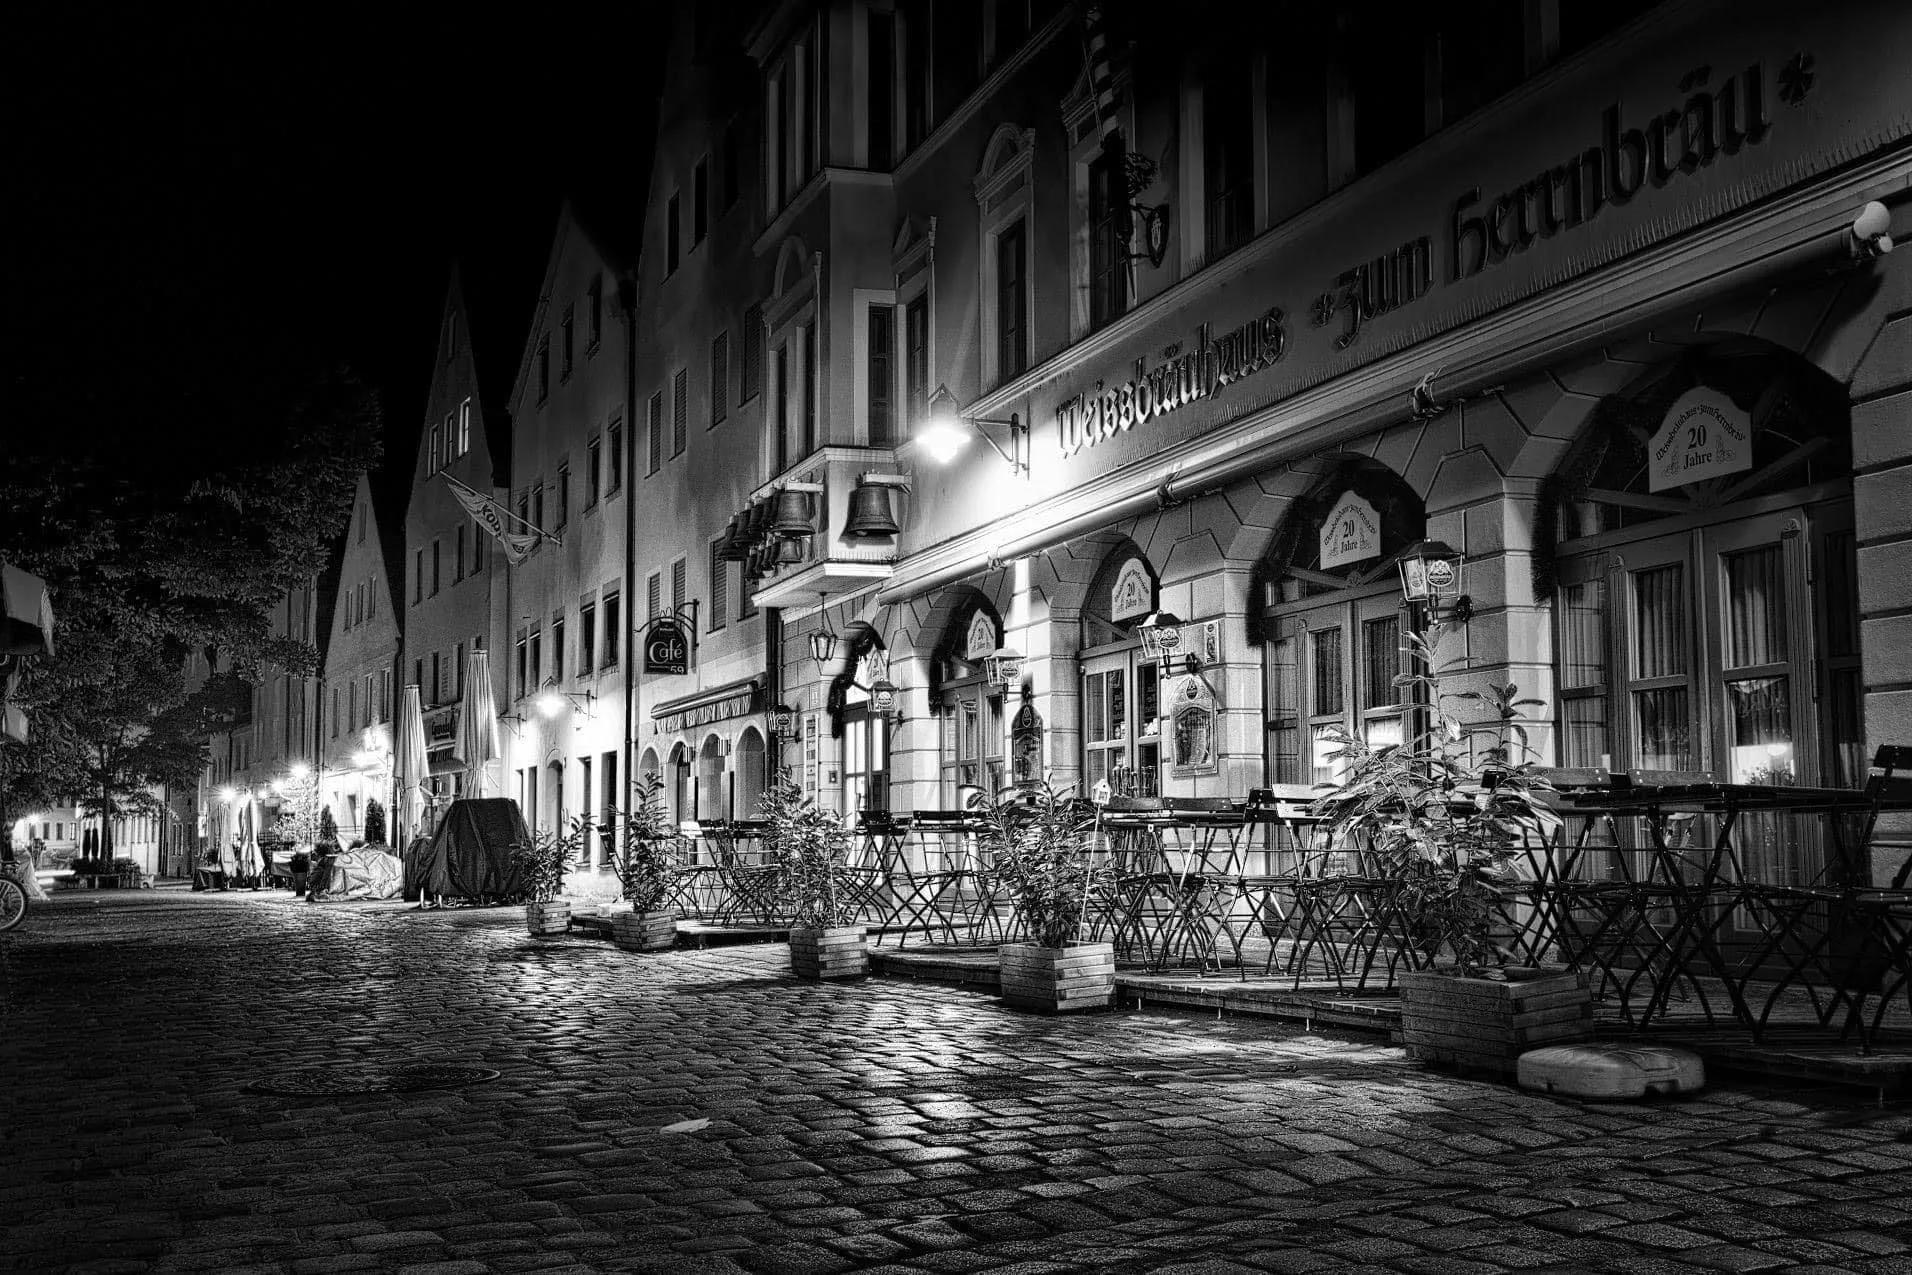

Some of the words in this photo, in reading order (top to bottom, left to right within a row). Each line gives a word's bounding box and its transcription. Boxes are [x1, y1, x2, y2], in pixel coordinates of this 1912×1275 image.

[1055, 306, 1286, 459] Weissbräuhaus
[1452, 60, 1773, 282] Herrnbräu
[1687, 424, 1706, 450] 20
[1683, 451, 1712, 470] Jahre
[1342, 520, 1355, 538] 20
[648, 638, 683, 665] Café
[670, 665, 685, 674] 59
